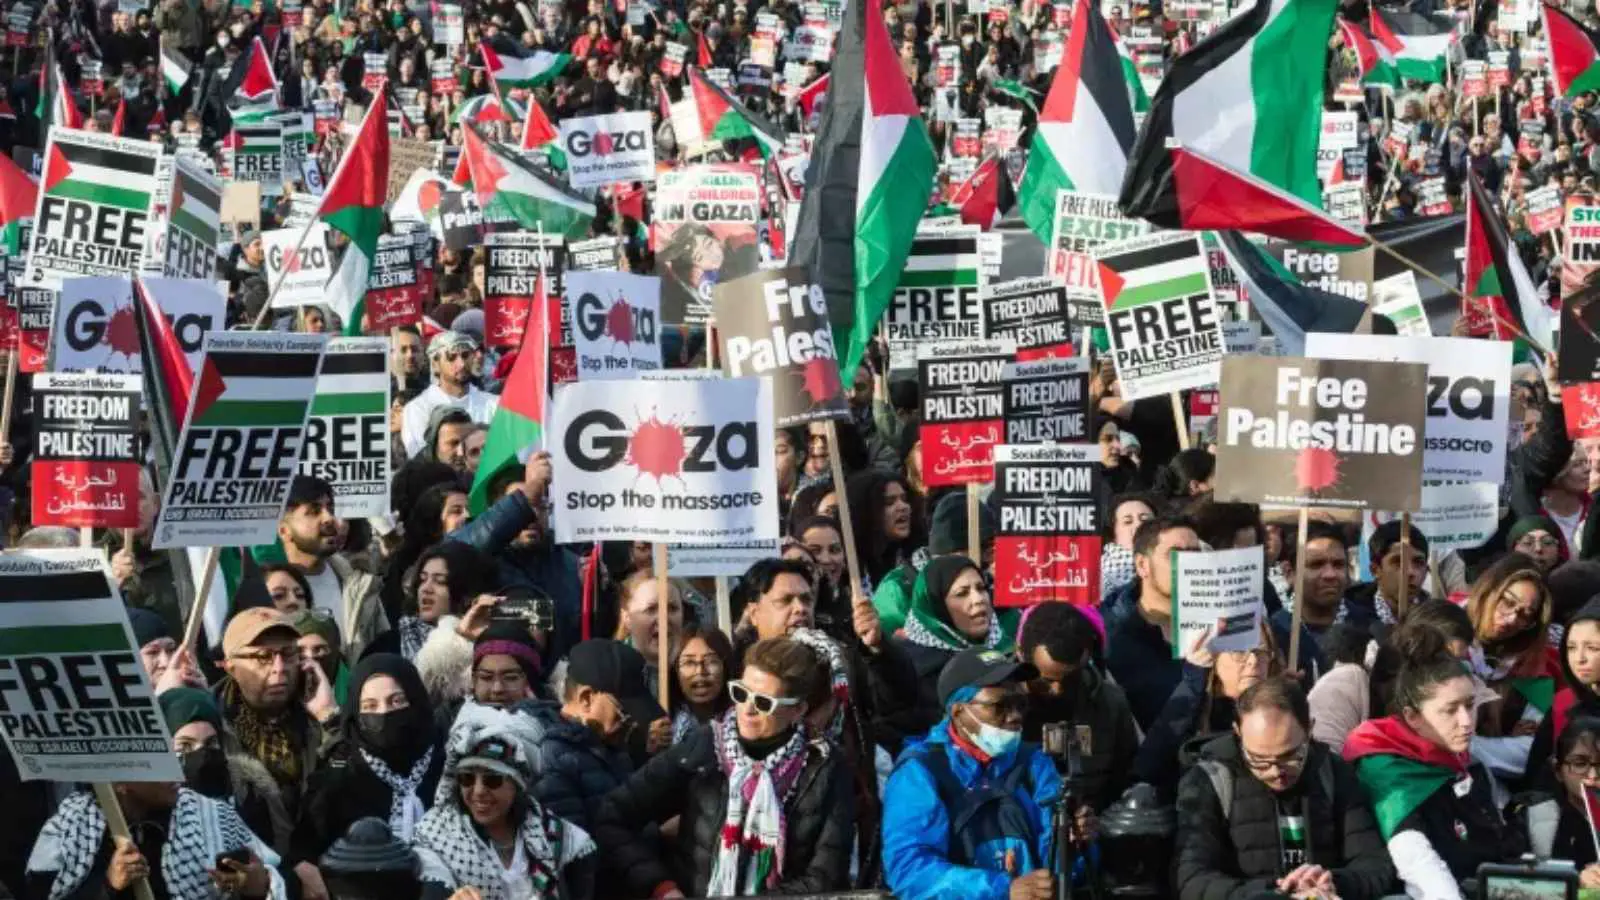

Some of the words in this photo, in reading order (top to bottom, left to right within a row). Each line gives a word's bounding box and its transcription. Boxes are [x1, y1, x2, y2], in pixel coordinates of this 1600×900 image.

[567, 130, 646, 157] Gza
[235, 155, 280, 171] FREE
[38, 197, 147, 250] FREE
[663, 203, 684, 220] IN
[692, 202, 753, 221] GAZA
[34, 236, 142, 269] PALESTINE
[270, 244, 325, 273] Gza
[1283, 249, 1340, 273] Free
[763, 279, 826, 322] Fre
[888, 287, 979, 322] FREE
[990, 292, 1060, 321] FREEDOM
[577, 292, 656, 346] Gza
[888, 322, 980, 340] PALESTINE
[1108, 292, 1217, 350] FREE
[207, 338, 247, 350] Palestine
[247, 338, 284, 351] Solidarity
[286, 339, 323, 351] Campaign
[932, 345, 969, 356] Socialist
[1118, 330, 1221, 368] PALESTINE
[604, 354, 629, 368] the
[49, 377, 89, 388] Socialist
[90, 377, 125, 389] Worker
[1011, 378, 1082, 408] FREEDOM
[1276, 366, 1368, 410] Free
[43, 394, 130, 421] FREEDOM
[924, 393, 1004, 421] PALESTIN
[1425, 374, 1496, 420] za
[78, 418, 93, 432] for
[300, 415, 386, 460] REE
[1007, 412, 1086, 444] PALESTINE
[1226, 407, 1417, 456] Palestine
[38, 431, 134, 458] PALESTINE
[564, 409, 760, 473] Gza
[940, 426, 999, 452] الحرية
[175, 428, 303, 479] FREE
[54, 464, 117, 491] الحرية
[1005, 467, 1093, 493] FREEDOM
[46, 489, 126, 515] لفلسطين
[168, 480, 290, 505] PALESTINE
[566, 491, 616, 512] Stop
[621, 488, 656, 509] the
[661, 489, 764, 512] massacre
[1042, 491, 1058, 504] for
[1000, 505, 1096, 532] PALESTINE
[1015, 541, 1080, 568] الحرية
[1008, 567, 1089, 594] لفلسطين
[0, 653, 153, 711] FREE
[1, 710, 162, 738] PALESTINE
